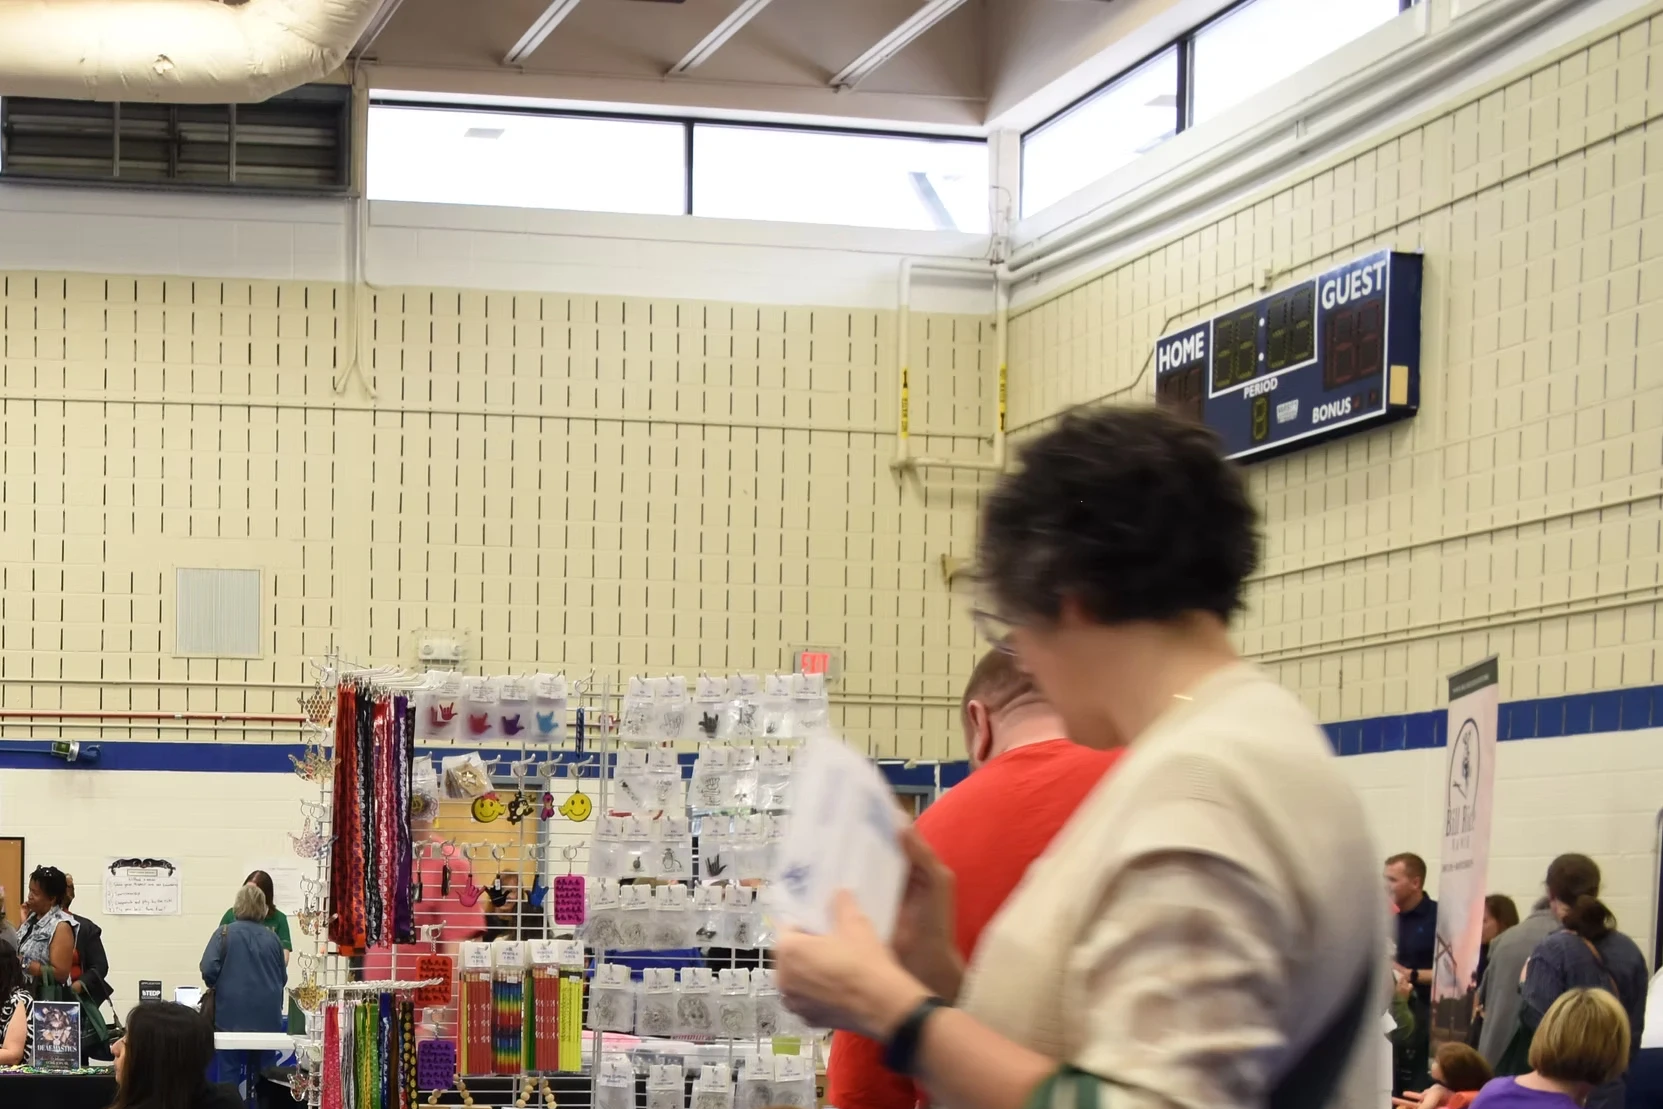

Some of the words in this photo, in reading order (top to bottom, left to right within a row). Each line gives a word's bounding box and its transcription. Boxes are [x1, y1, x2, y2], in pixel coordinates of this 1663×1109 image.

[1321, 261, 1386, 310] GUEST
[1159, 331, 1205, 373] HOME
[1243, 377, 1279, 399] PERIOD
[1312, 397, 1352, 424] BONUS
